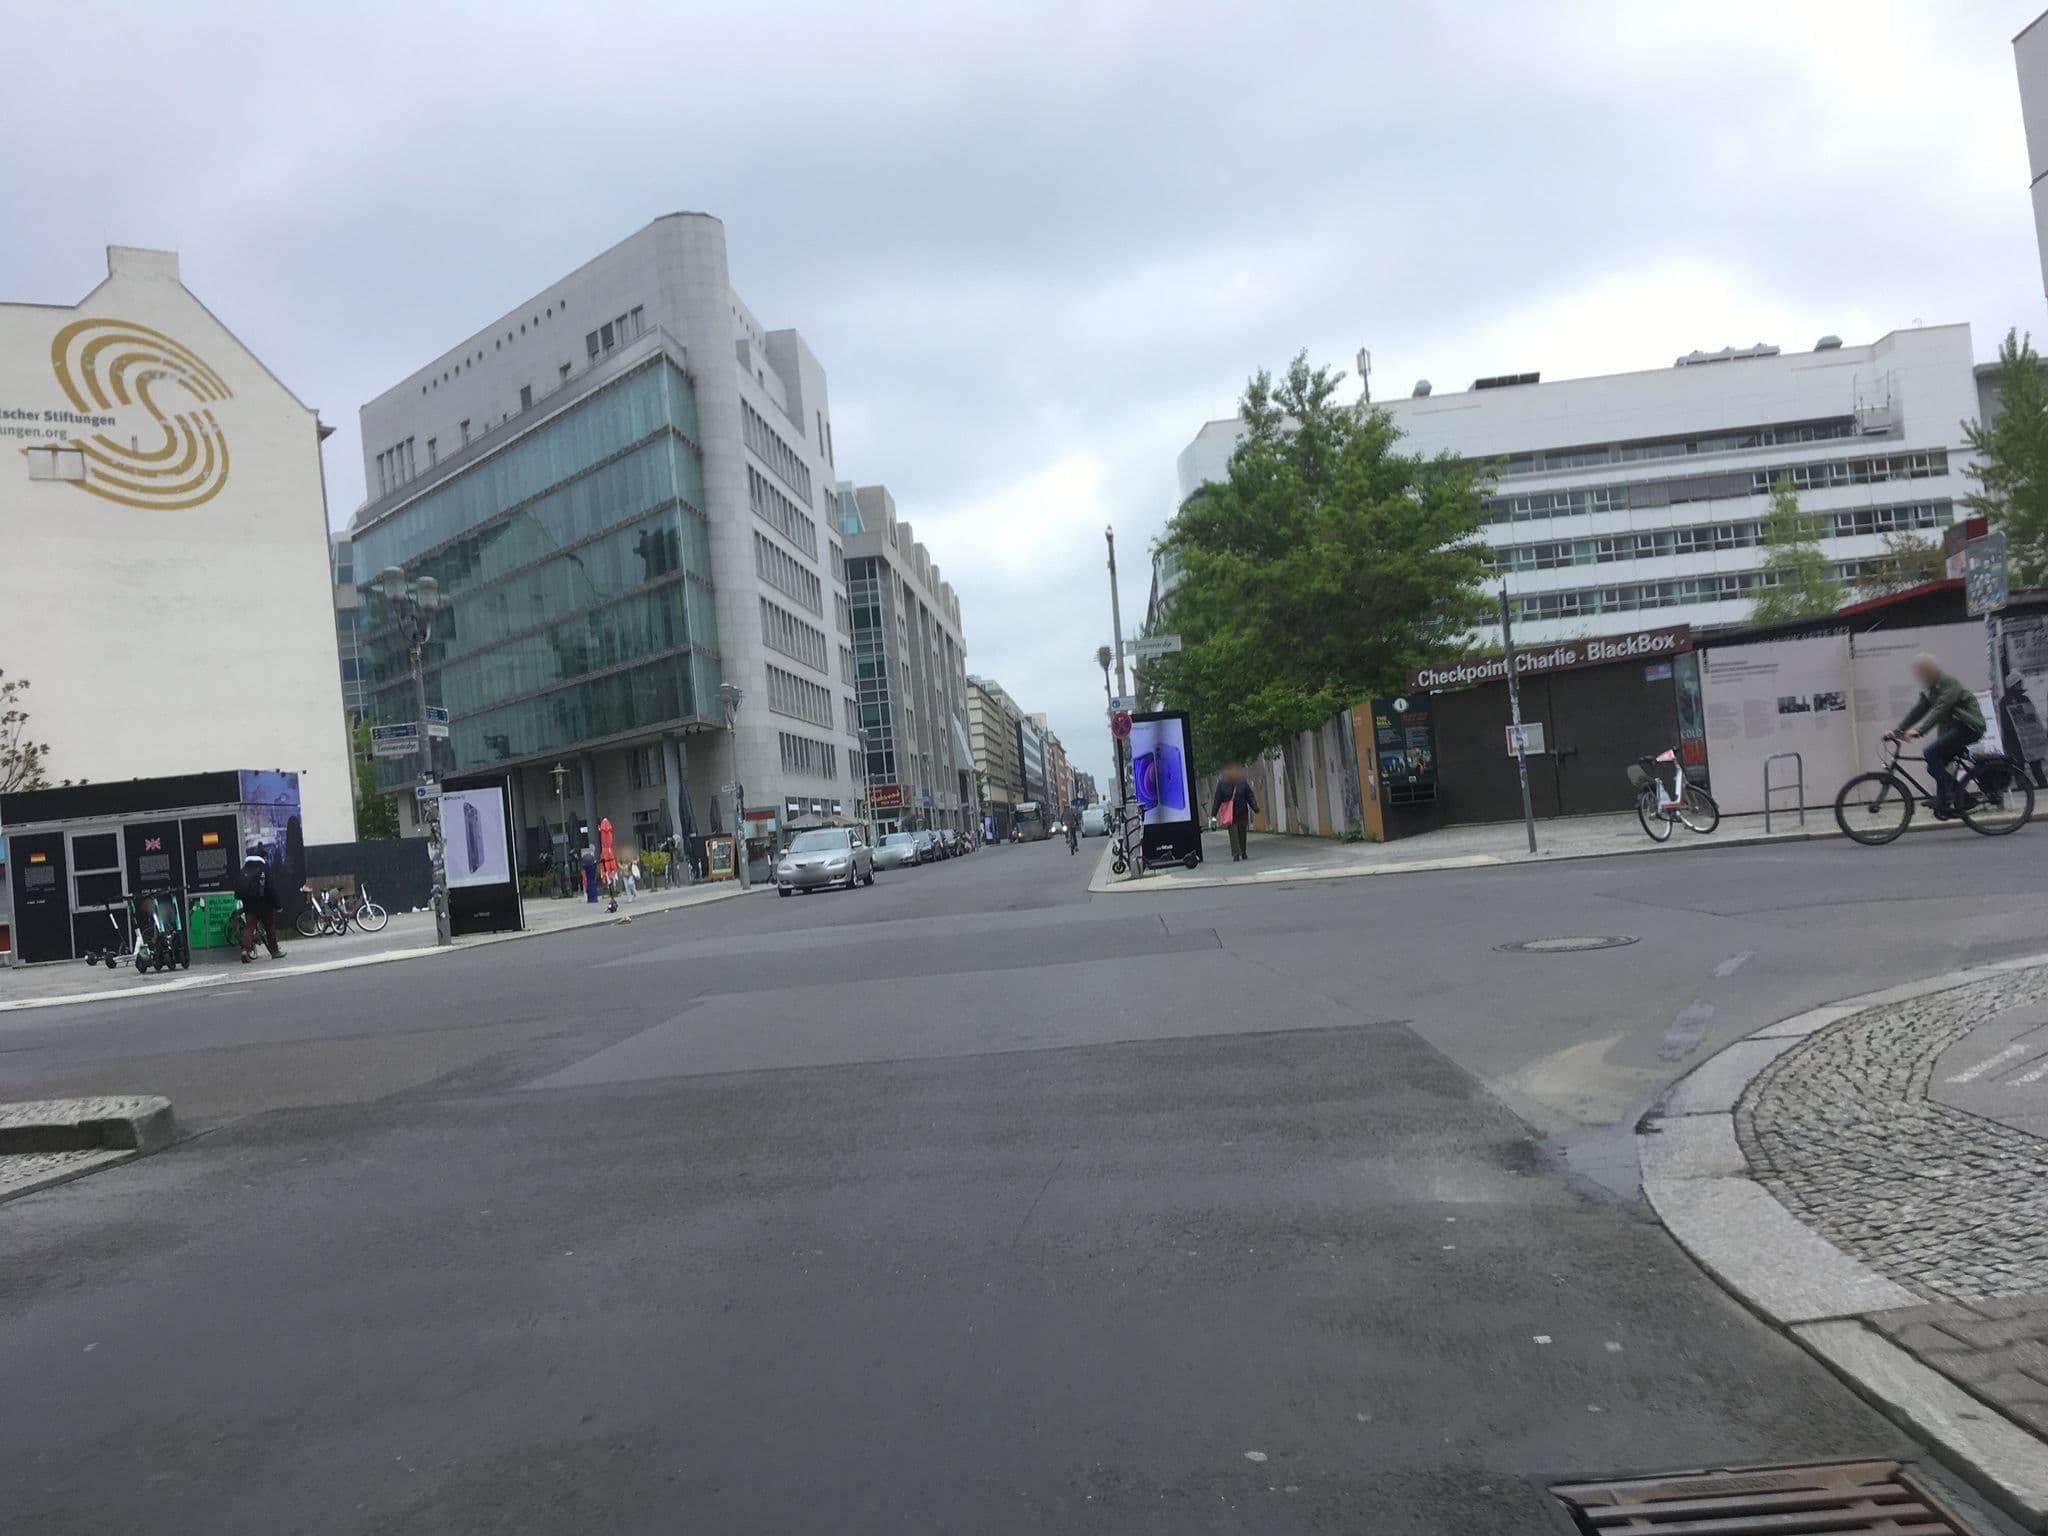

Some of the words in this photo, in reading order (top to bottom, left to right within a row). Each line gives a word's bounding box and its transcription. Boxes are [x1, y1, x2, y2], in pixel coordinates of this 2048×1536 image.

[44, 410, 116, 427] Stiftungen
[0, 427, 67, 440] ungen.org
[1418, 658, 1509, 687] Checkpoint
[1515, 647, 1577, 672] Charlie
[1587, 633, 1676, 661] BlackBox
